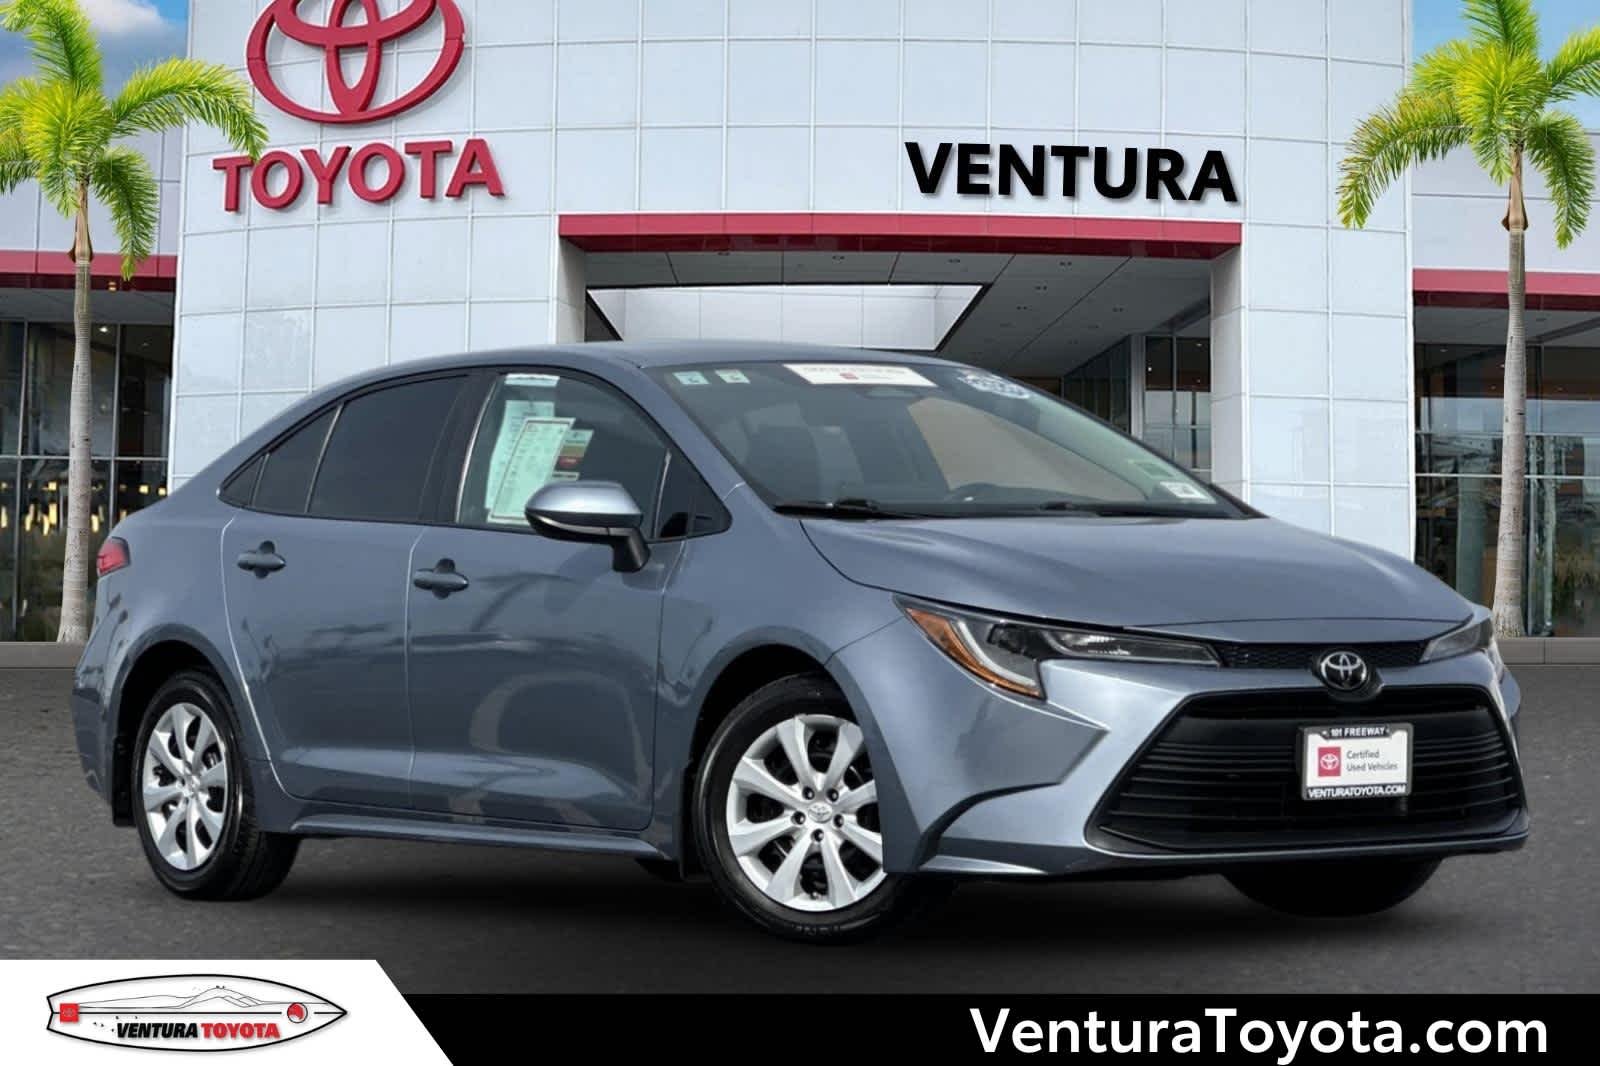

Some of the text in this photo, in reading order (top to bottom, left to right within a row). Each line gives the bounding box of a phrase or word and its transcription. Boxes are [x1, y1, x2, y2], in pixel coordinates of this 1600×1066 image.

[212, 138, 505, 213] TOYOTA
[905, 141, 1237, 202] VENTURA
[1331, 727, 1385, 737] 101 FREEWAY
[1346, 750, 1380, 759] Certified
[1346, 761, 1398, 772] Used Vehicles
[1308, 785, 1406, 798] VENTURATOYOTA.COM
